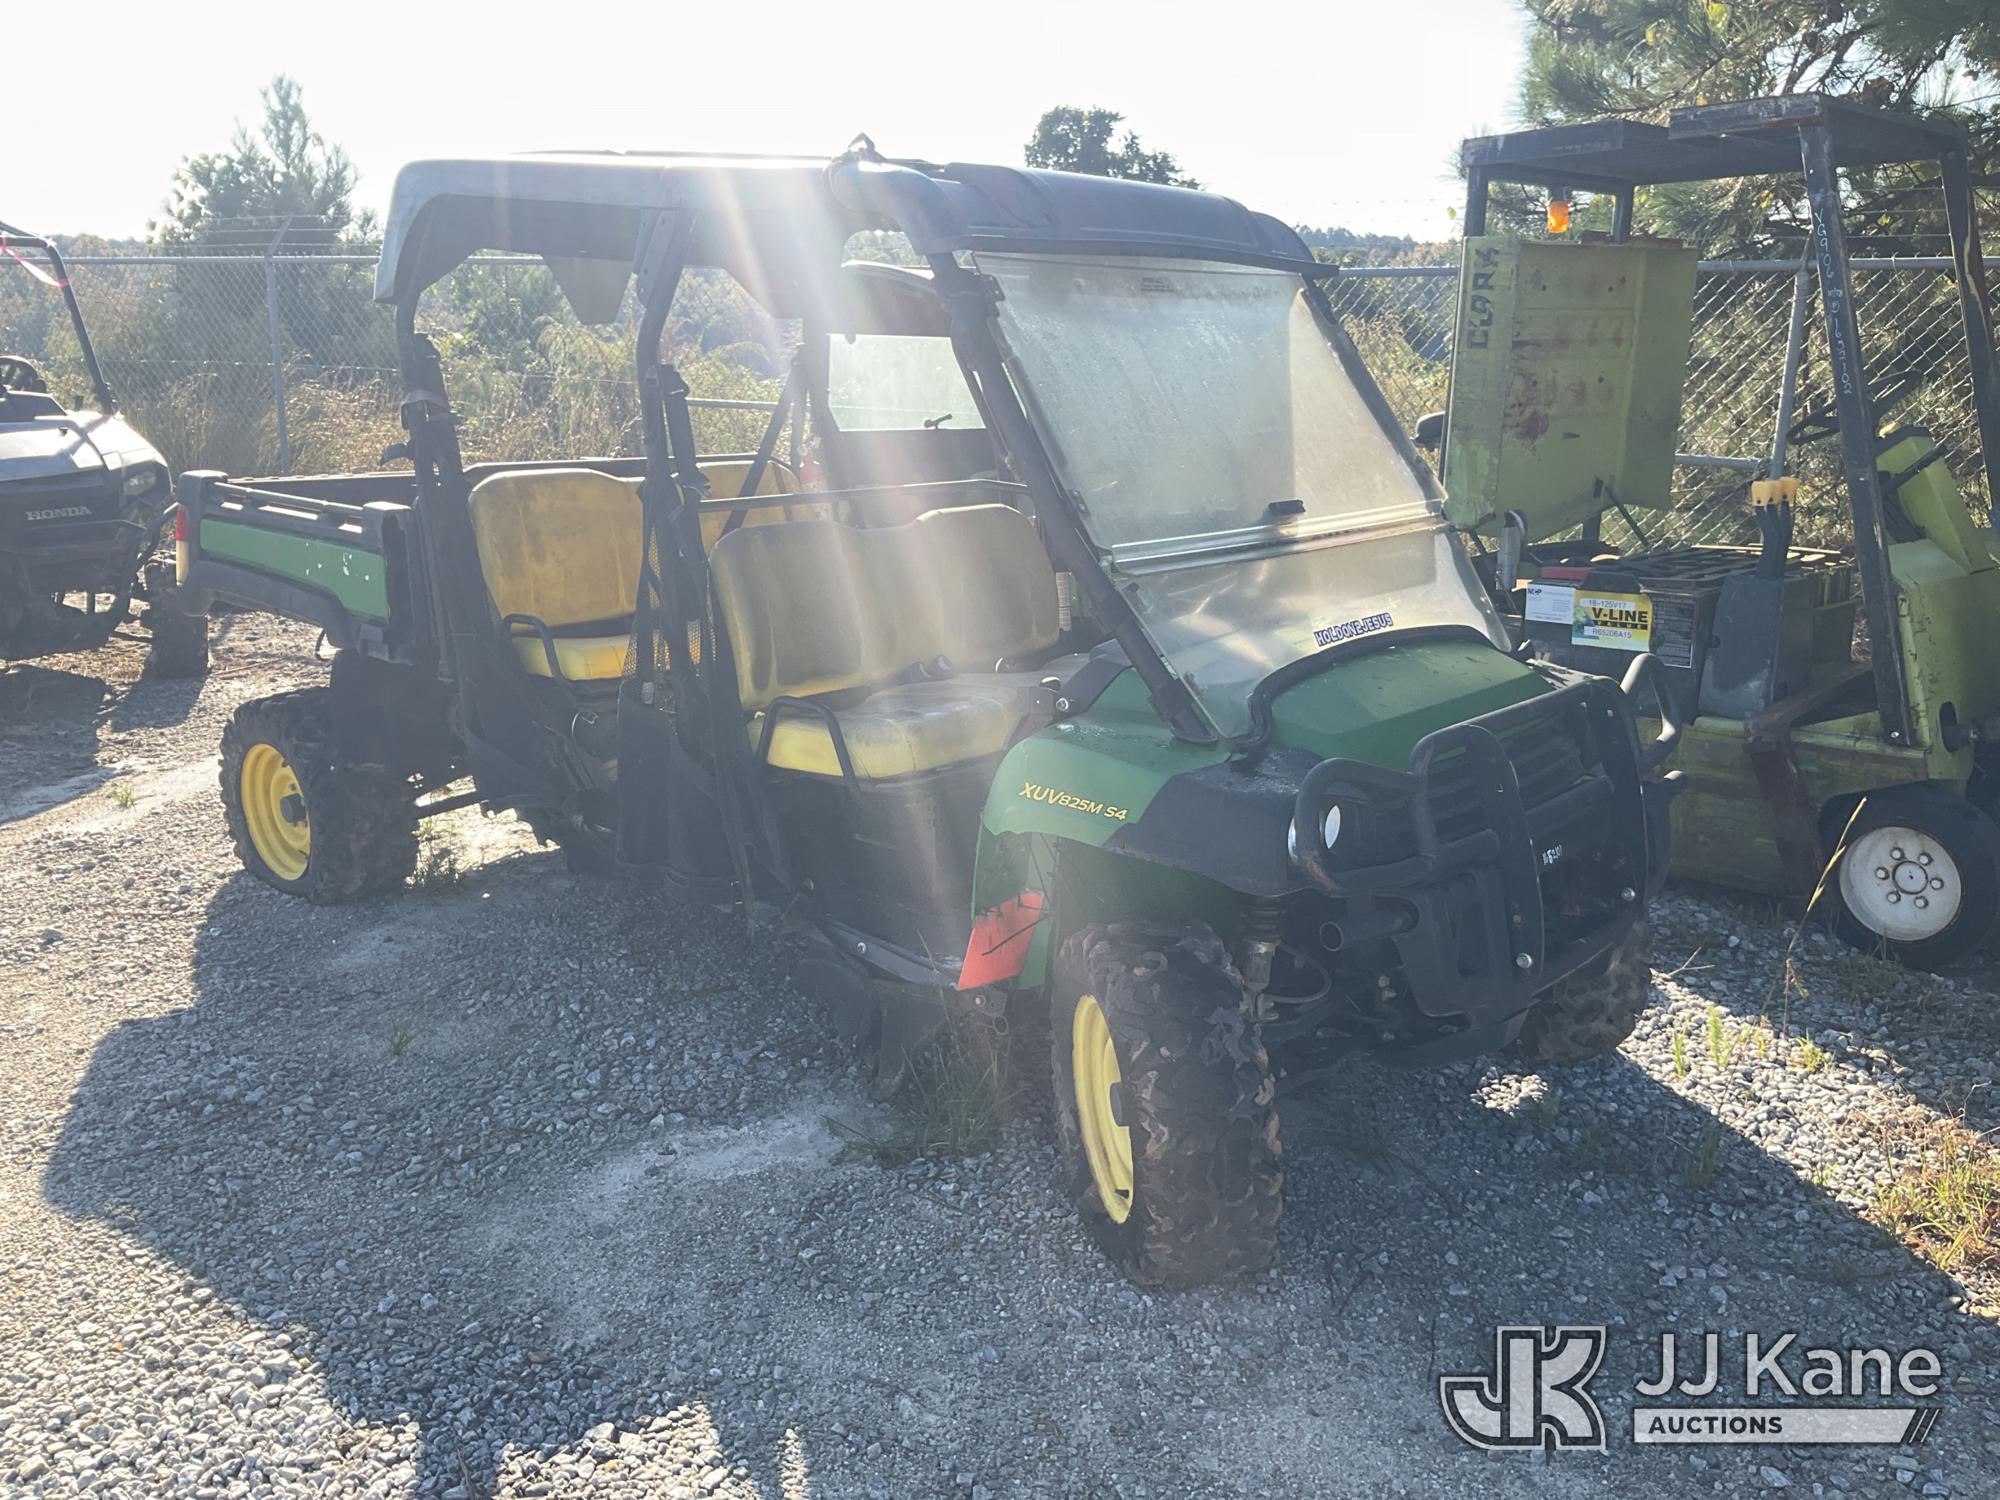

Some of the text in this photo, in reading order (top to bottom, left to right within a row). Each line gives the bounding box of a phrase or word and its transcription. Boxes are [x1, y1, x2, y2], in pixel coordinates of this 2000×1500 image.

[25, 506, 92, 520] HONDA
[1592, 607, 1648, 623] V-LINE
[1314, 612, 1394, 647] HOLDON2JESUS
[1019, 782, 1128, 820] XUV825M S4
